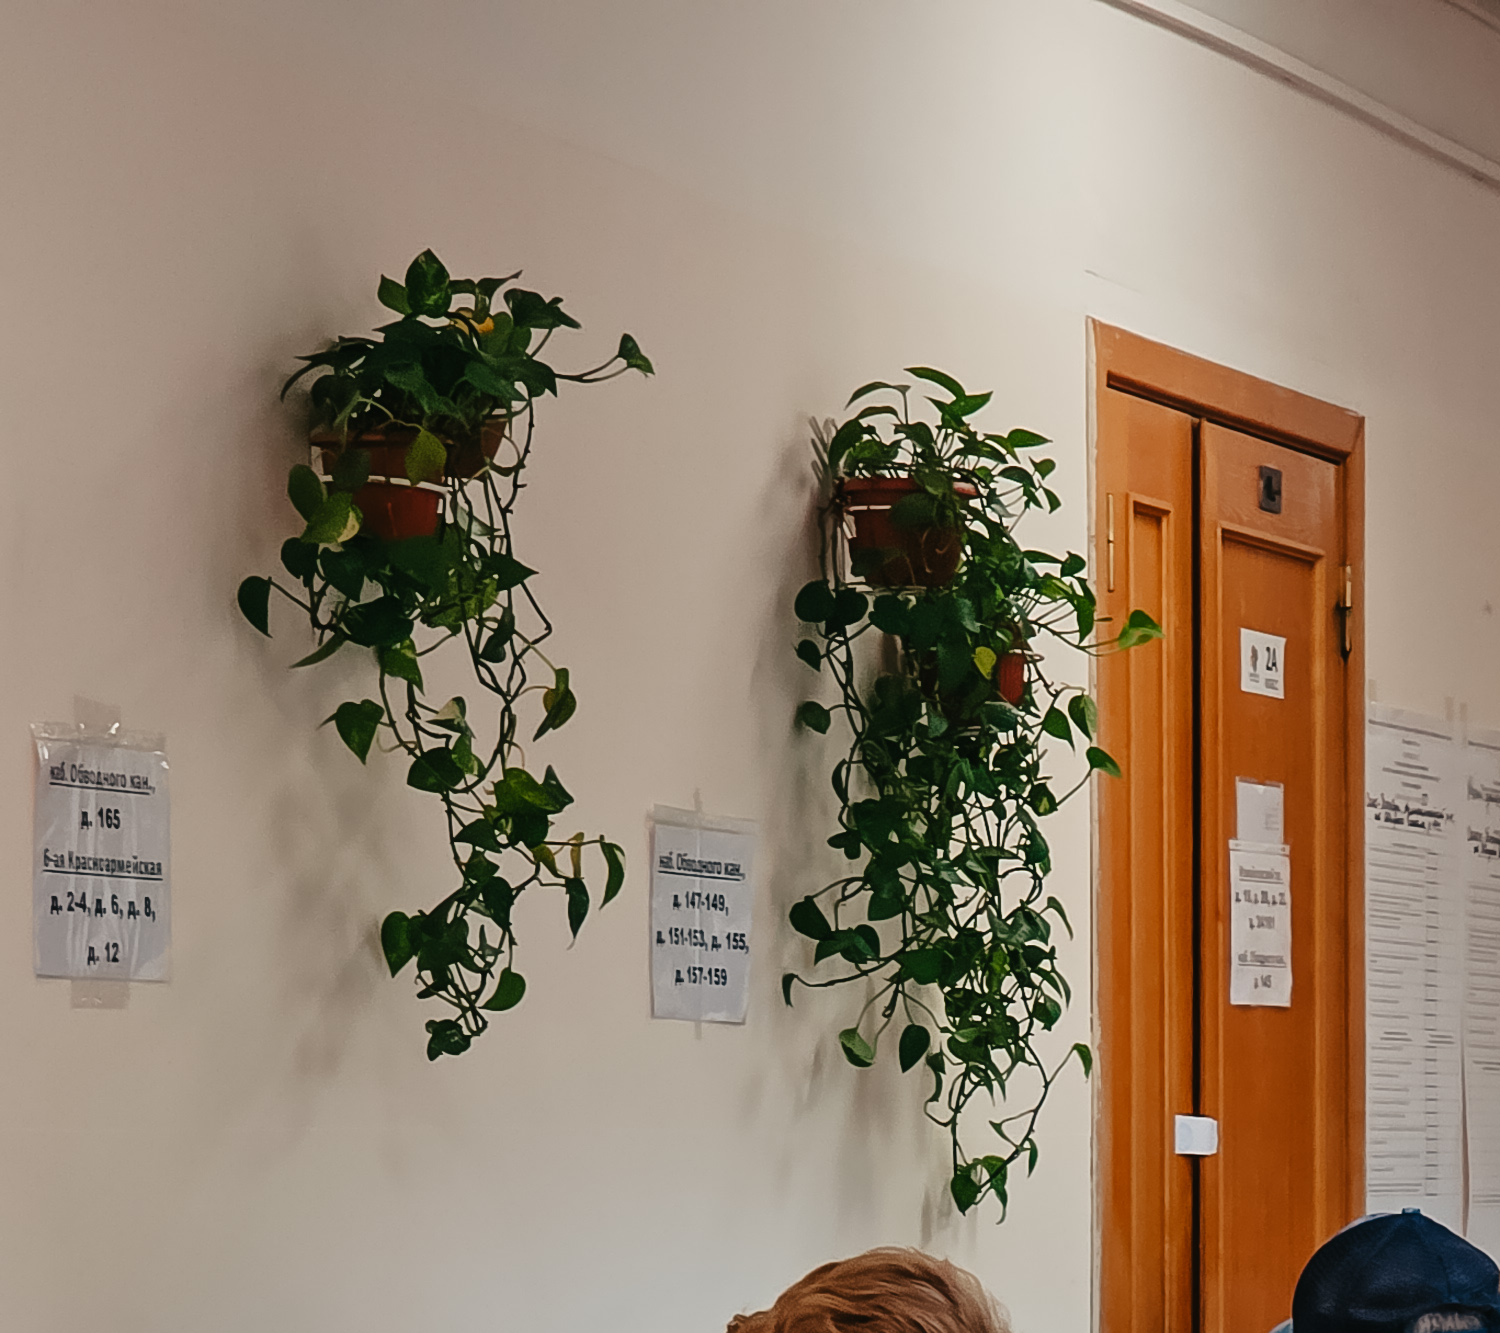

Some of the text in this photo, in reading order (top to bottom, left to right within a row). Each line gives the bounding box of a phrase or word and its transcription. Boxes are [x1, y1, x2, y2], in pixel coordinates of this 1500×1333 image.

[70, 763, 127, 788] Обводного
[80, 806, 121, 830] д. 165
[68, 850, 162, 876] Красноармейская
[50, 891, 156, 922] д. 2-4, д. 6, д. 8,
[685, 891, 728, 917] 147-149,
[668, 927, 708, 952] 151-153,
[726, 932, 749, 955] 155,
[87, 942, 120, 966] д. 12
[687, 965, 728, 987] 157-159
